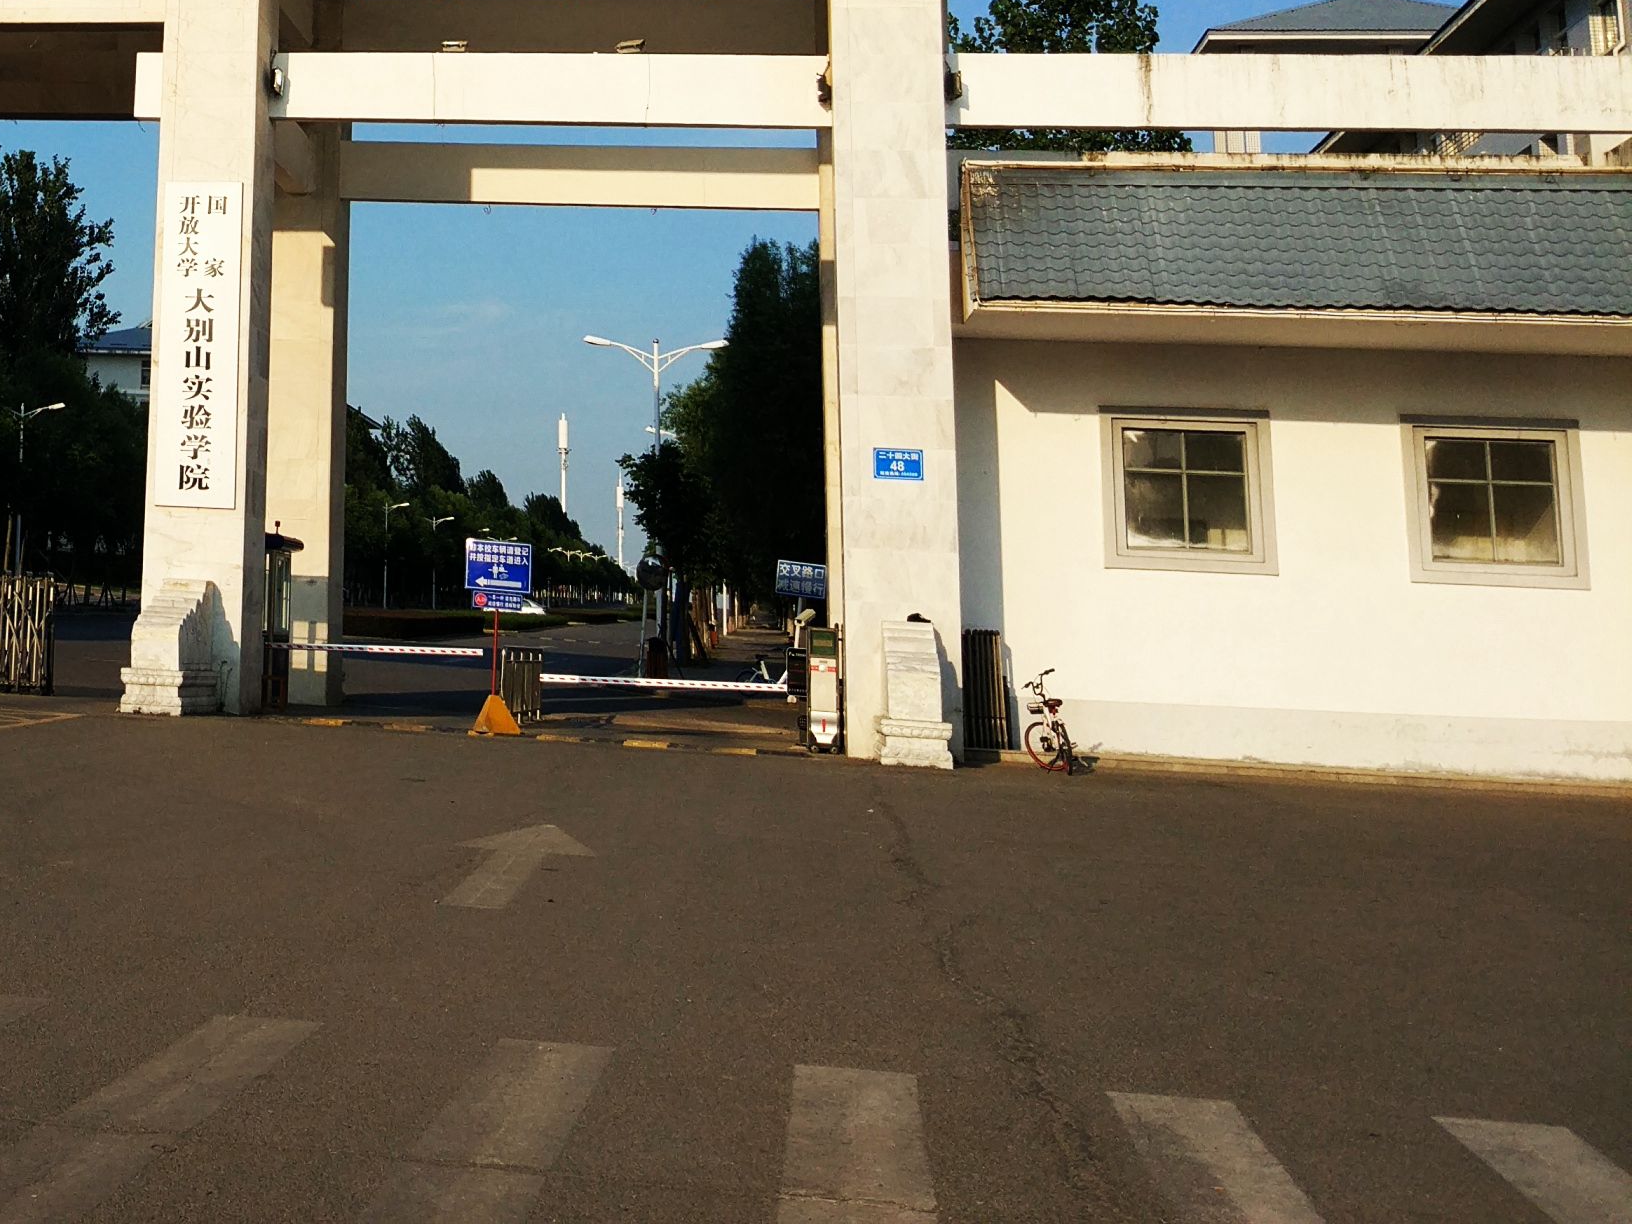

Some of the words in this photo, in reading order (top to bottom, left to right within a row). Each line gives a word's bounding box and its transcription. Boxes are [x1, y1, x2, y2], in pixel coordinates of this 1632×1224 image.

[176, 195, 201, 278] 开放大学
[204, 194, 227, 278] 国家
[178, 287, 215, 491] 大别山实验学院
[889, 460, 905, 472] 48
[779, 563, 825, 579] 交叉路口
